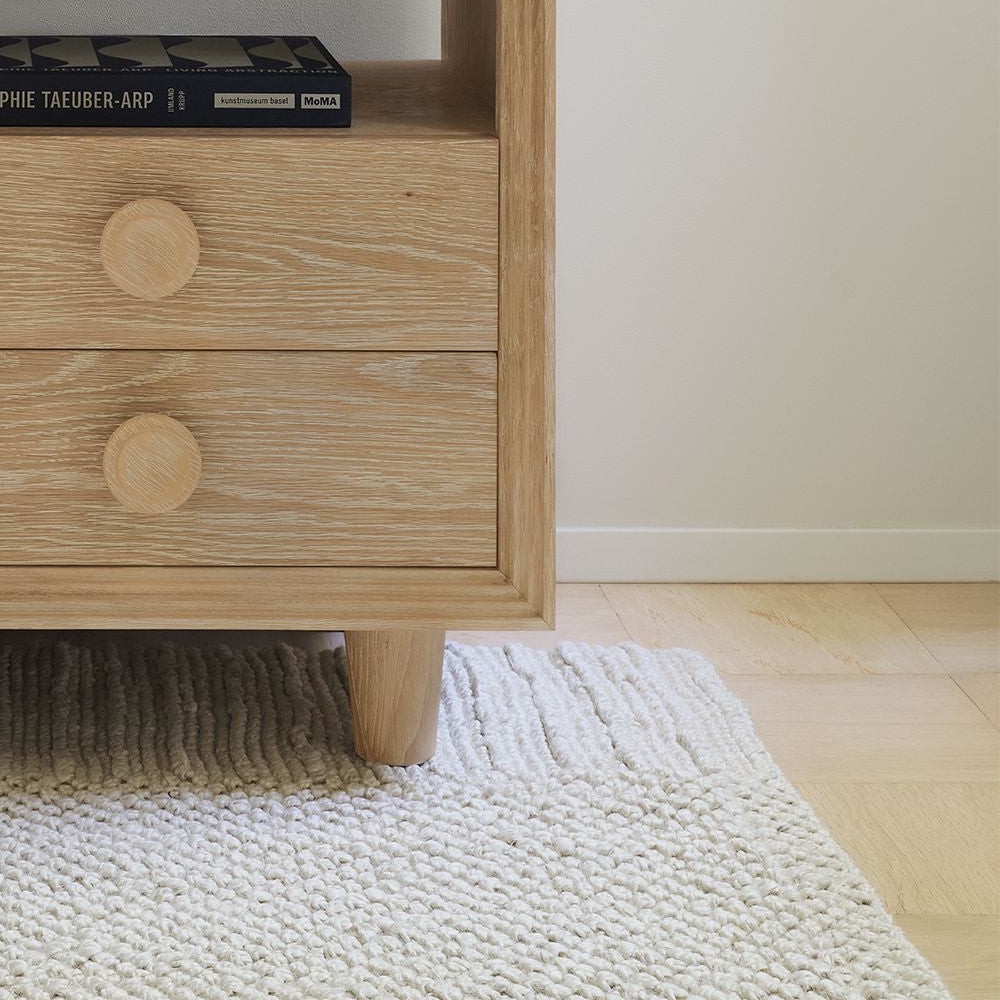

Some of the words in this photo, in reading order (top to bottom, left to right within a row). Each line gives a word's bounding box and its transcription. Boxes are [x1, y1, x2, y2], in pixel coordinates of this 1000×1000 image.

[41, 90, 154, 109] TAEUBER-ARP
[220, 96, 268, 105] kunstmuseum
[270, 96, 289, 105] basel
[304, 96, 337, 106] MoMA
